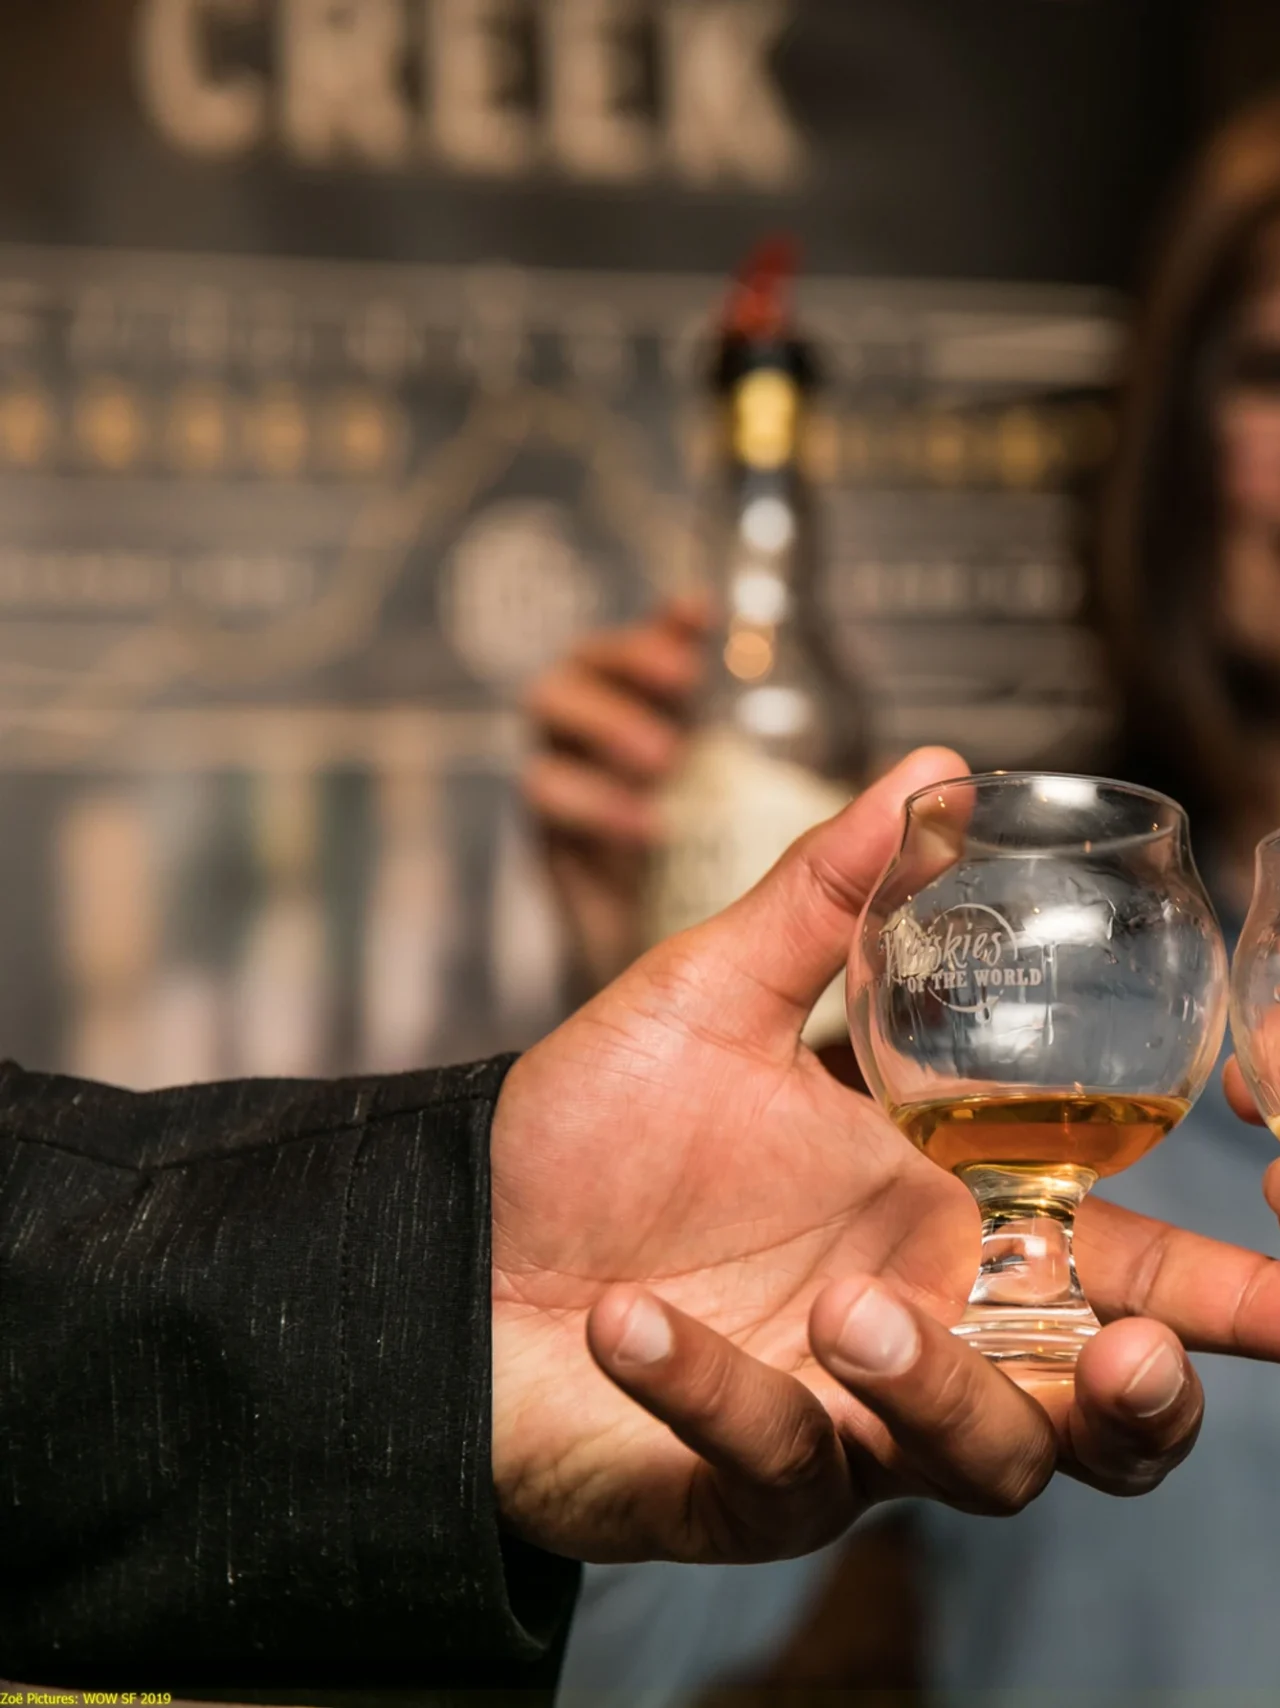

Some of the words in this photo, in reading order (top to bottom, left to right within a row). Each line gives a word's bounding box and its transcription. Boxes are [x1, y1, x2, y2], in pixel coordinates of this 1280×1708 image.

[135, 0, 806, 186] CREEK
[907, 976, 927, 993] OF
[931, 971, 967, 989] THE
[973, 967, 1042, 987] WORLD
